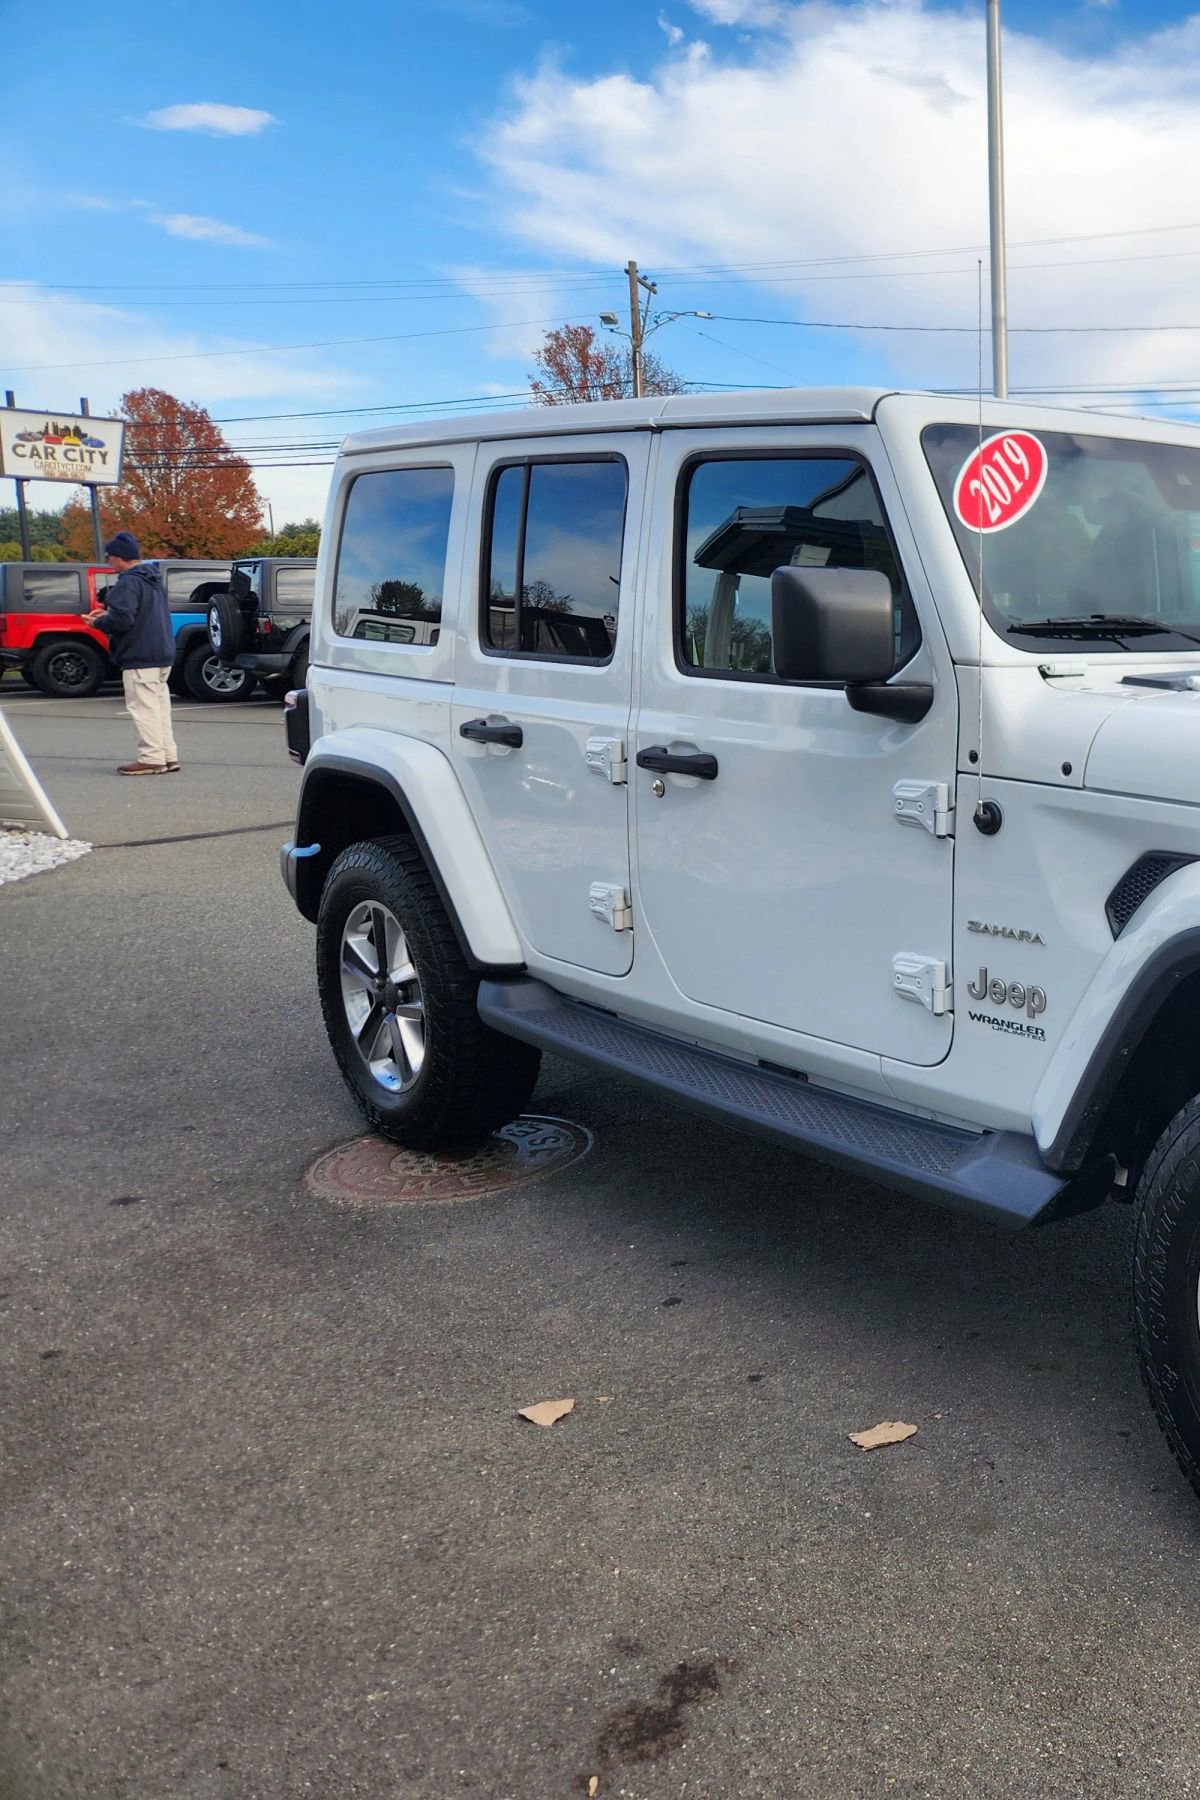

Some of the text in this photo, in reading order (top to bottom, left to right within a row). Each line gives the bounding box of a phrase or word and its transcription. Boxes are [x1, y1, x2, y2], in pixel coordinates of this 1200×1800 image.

[11, 442, 109, 465] CAR CITY
[969, 437, 1030, 524] 2019
[966, 920, 1047, 946] SAHARA
[967, 966, 1047, 1020] Jeep
[968, 1010, 1046, 1038] WRANGLER
[992, 1025, 1047, 1042] UNLIMITED
